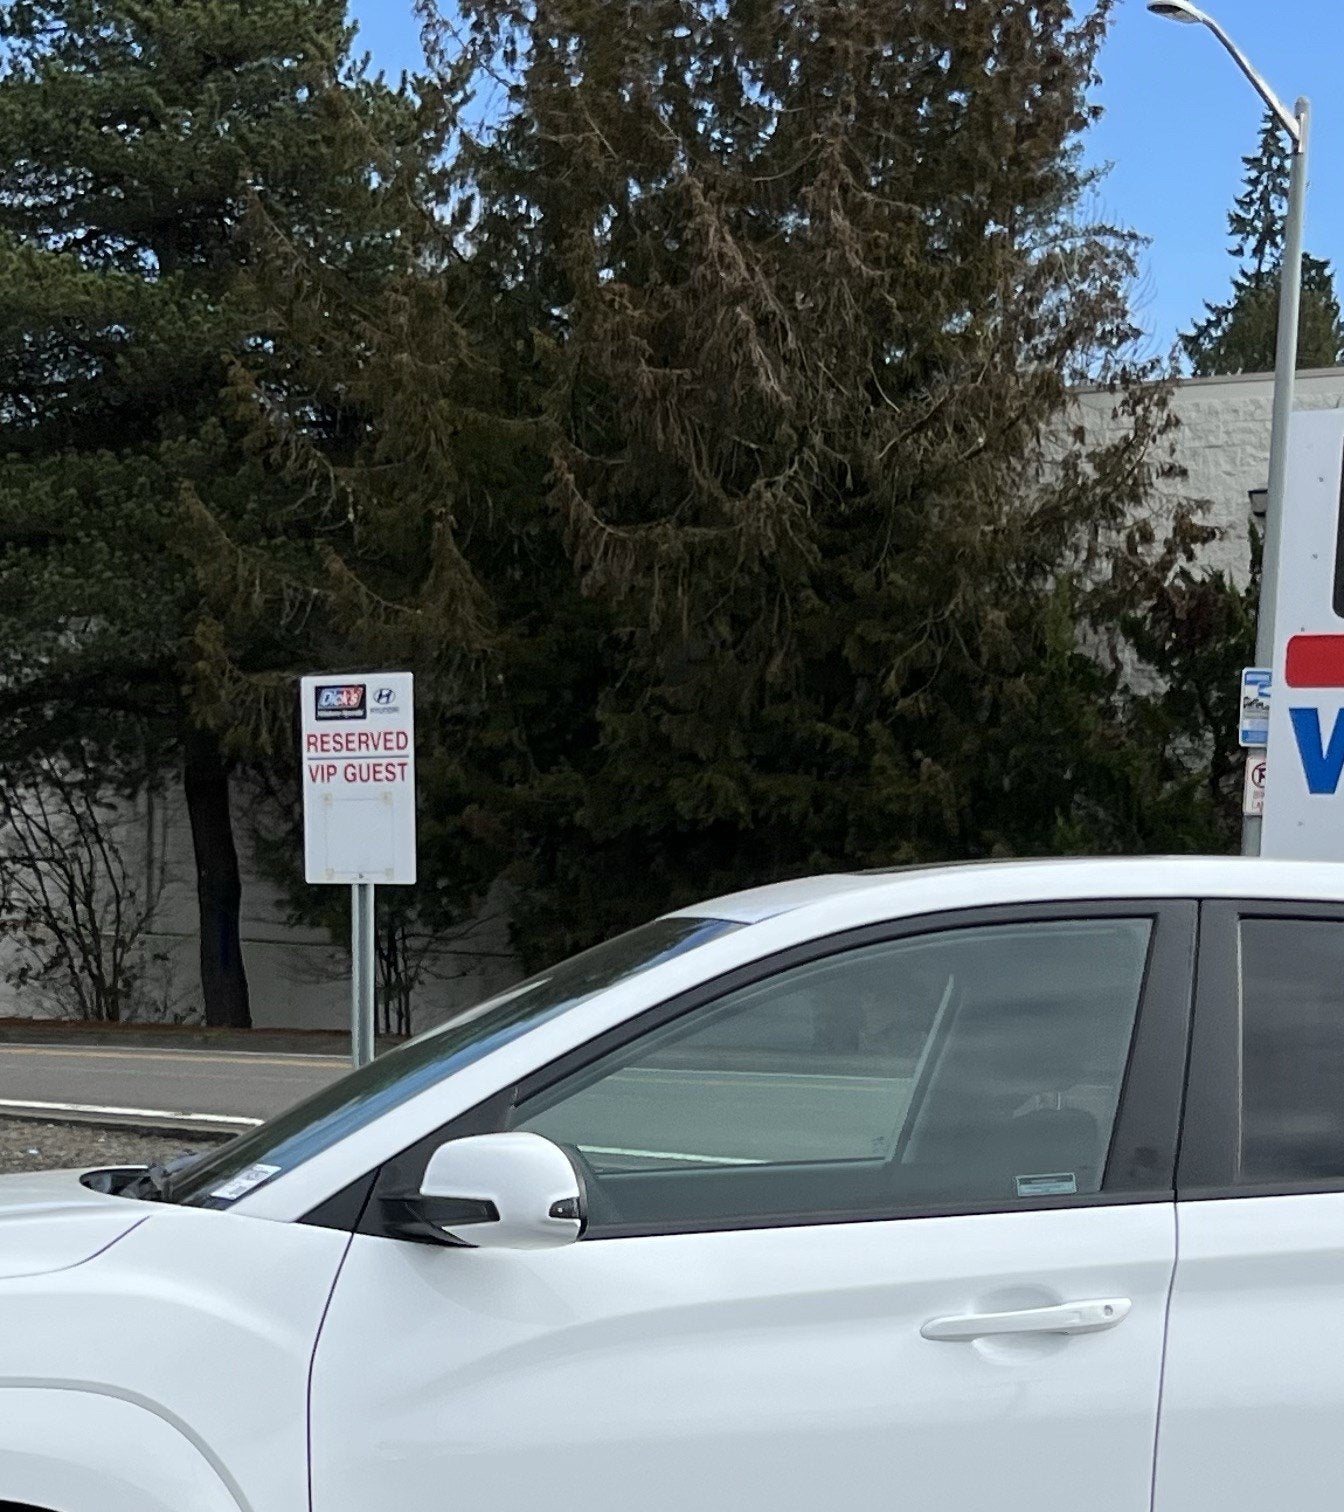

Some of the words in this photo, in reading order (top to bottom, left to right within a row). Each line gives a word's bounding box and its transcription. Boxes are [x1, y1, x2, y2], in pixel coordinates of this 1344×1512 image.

[307, 731, 408, 752] RESERVED
[308, 763, 338, 784] VIP
[343, 763, 408, 782] GUEST
